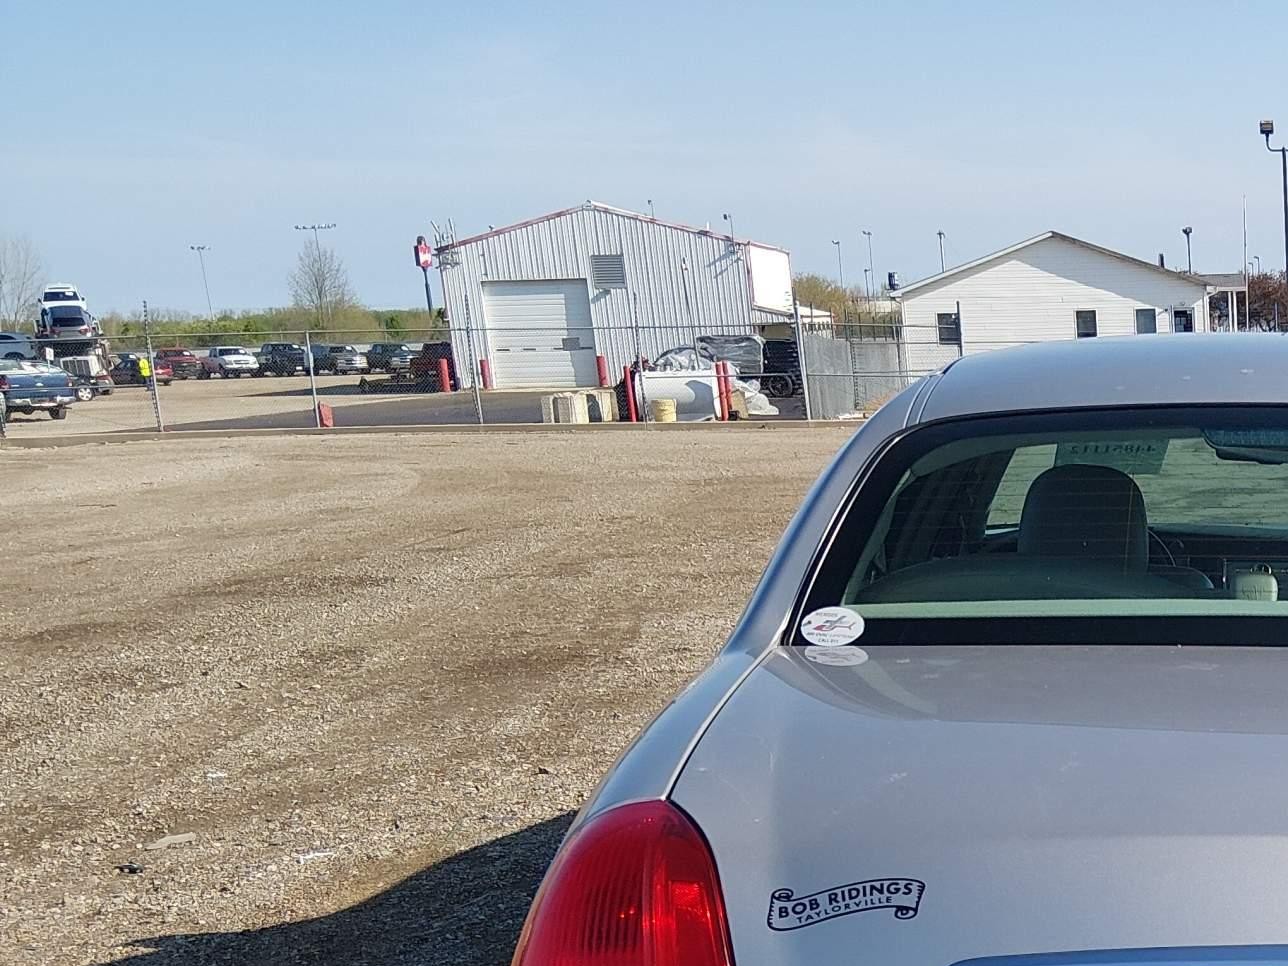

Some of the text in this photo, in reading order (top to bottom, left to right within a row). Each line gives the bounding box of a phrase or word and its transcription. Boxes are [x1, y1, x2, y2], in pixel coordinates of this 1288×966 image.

[778, 882, 913, 919] BOB RIDINGS
[796, 896, 893, 924] TAYLORVILLE
